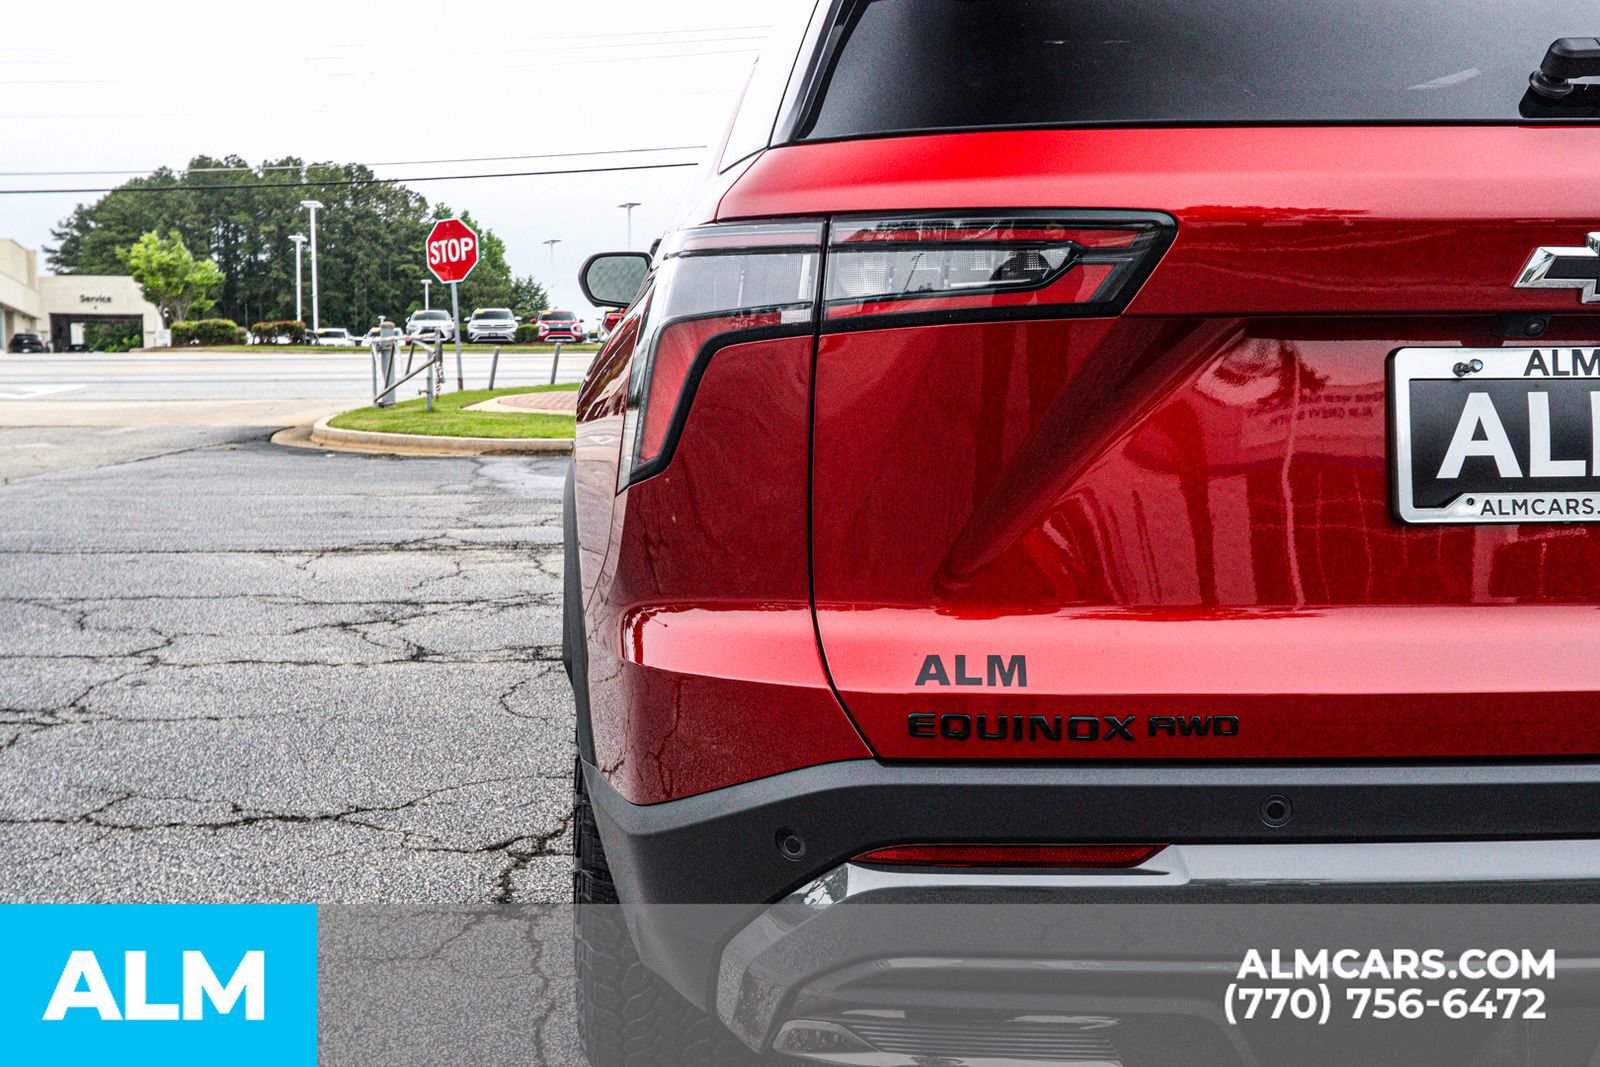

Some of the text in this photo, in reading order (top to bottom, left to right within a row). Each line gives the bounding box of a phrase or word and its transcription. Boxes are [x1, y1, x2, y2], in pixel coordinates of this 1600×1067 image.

[430, 237, 474, 265] STOP
[80, 295, 112, 303] Service
[1436, 391, 1600, 479] AL
[915, 655, 1028, 687] ALM
[907, 713, 1240, 742] EQUINOX AWD
